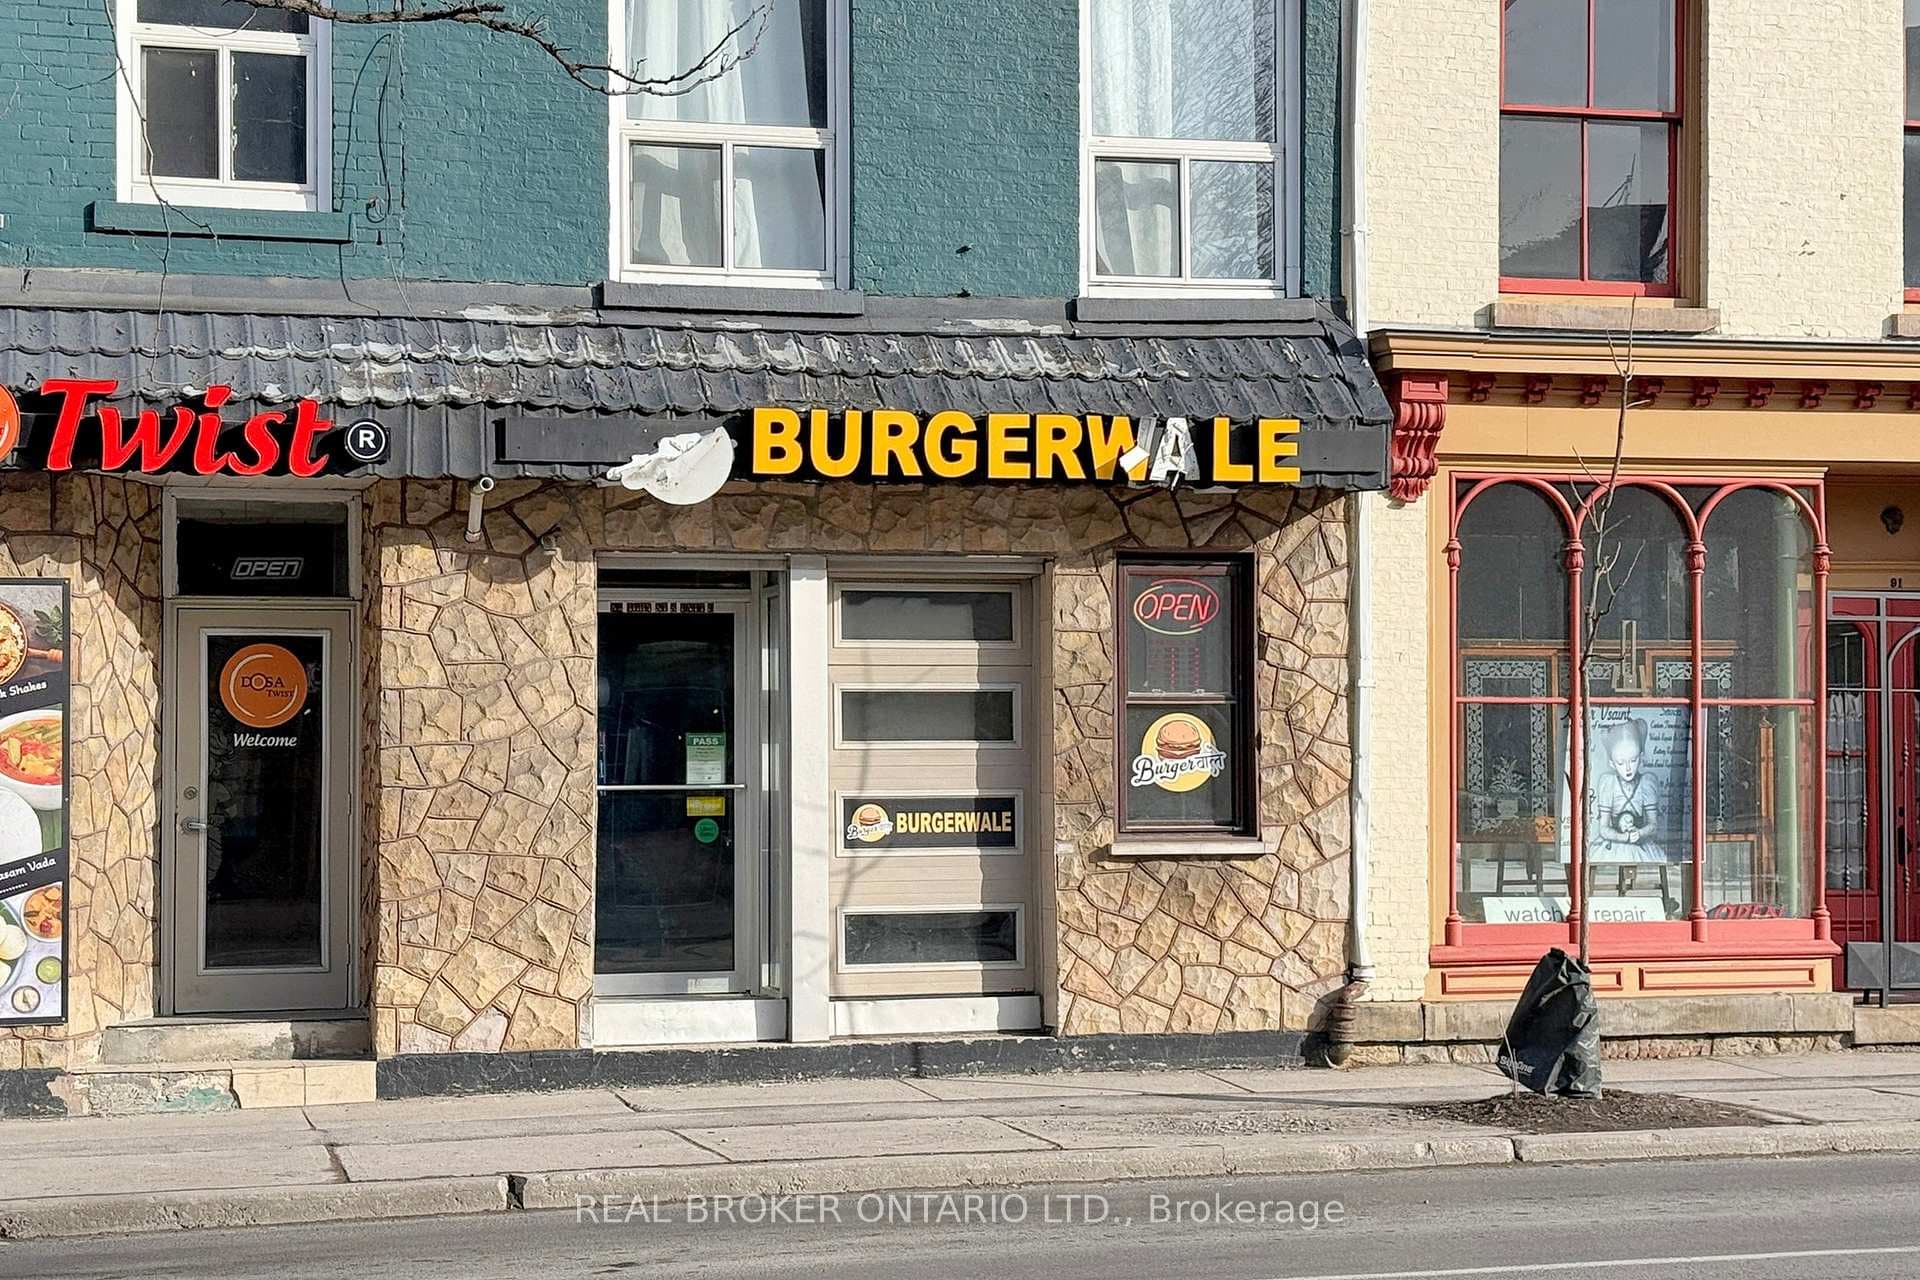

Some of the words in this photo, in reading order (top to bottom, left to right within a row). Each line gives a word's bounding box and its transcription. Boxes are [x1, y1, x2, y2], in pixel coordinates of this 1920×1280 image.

[41, 378, 335, 477] Twist
[752, 407, 1301, 484] BURGERWALE
[235, 561, 300, 577] OPEN
[1890, 578, 1904, 589] 91
[1138, 593, 1212, 621] OPEN
[9, 681, 48, 697] Shakes
[240, 672, 285, 692] DOSA
[233, 732, 298, 748] Welcome
[692, 736, 719, 746] PASS
[895, 811, 1012, 834] BURGERWALE
[26, 856, 57, 872] Vada
[1503, 905, 1565, 923] watch
[1593, 905, 1646, 923] repair
